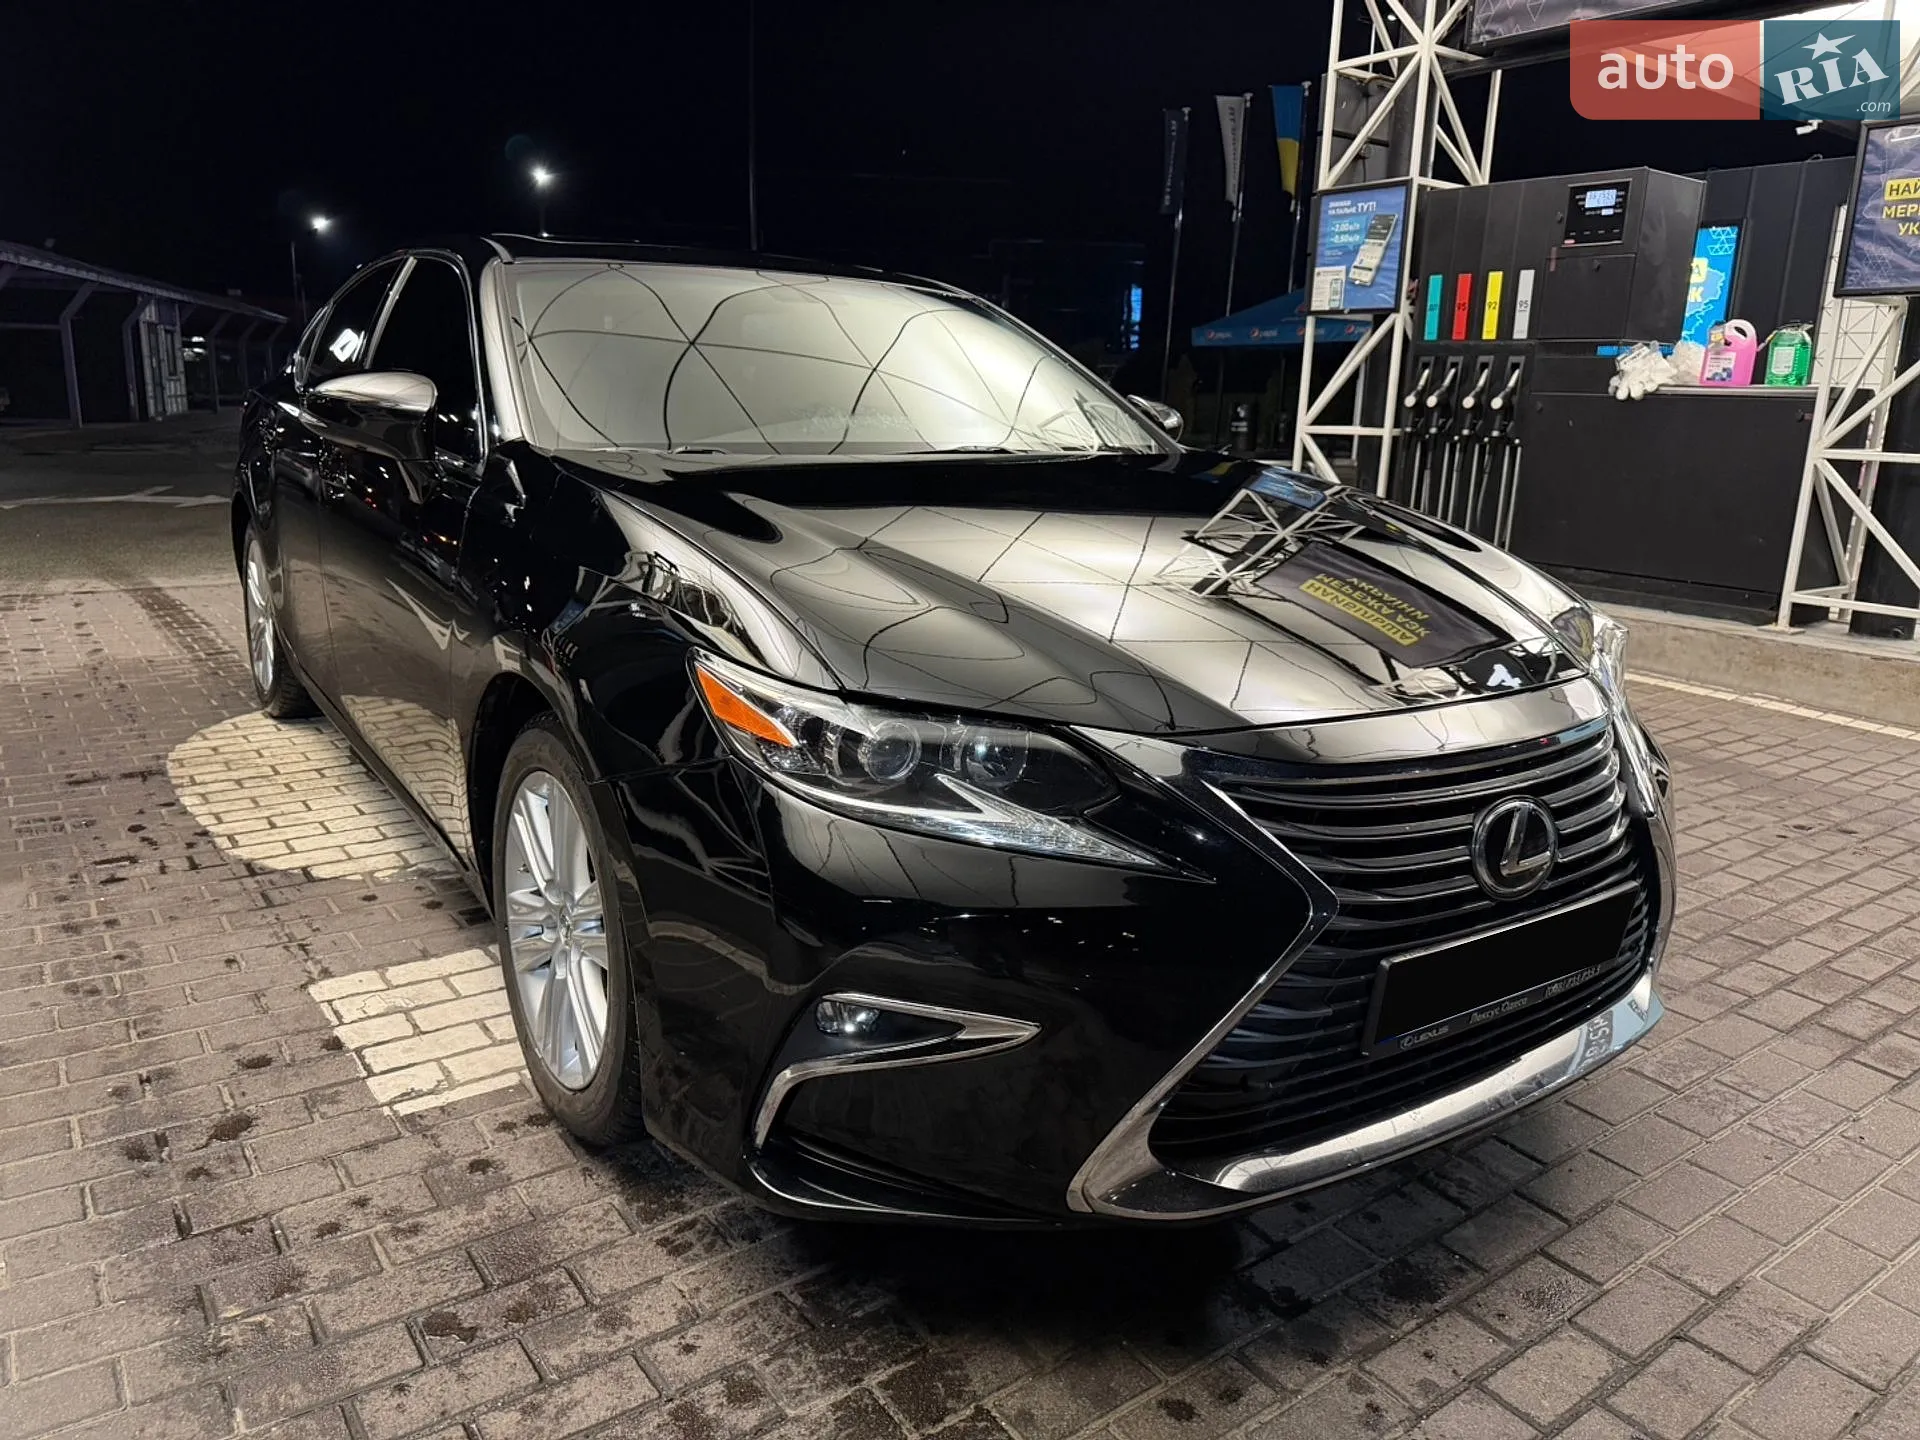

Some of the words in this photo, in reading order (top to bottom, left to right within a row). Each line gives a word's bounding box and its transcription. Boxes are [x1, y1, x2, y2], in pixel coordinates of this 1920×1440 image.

[1358, 201, 1376, 213] ТУТ!
[1882, 204, 1920, 219] МЕР
[1488, 301, 1497, 310] 92
[1414, 1025, 1449, 1043] LEXUS
